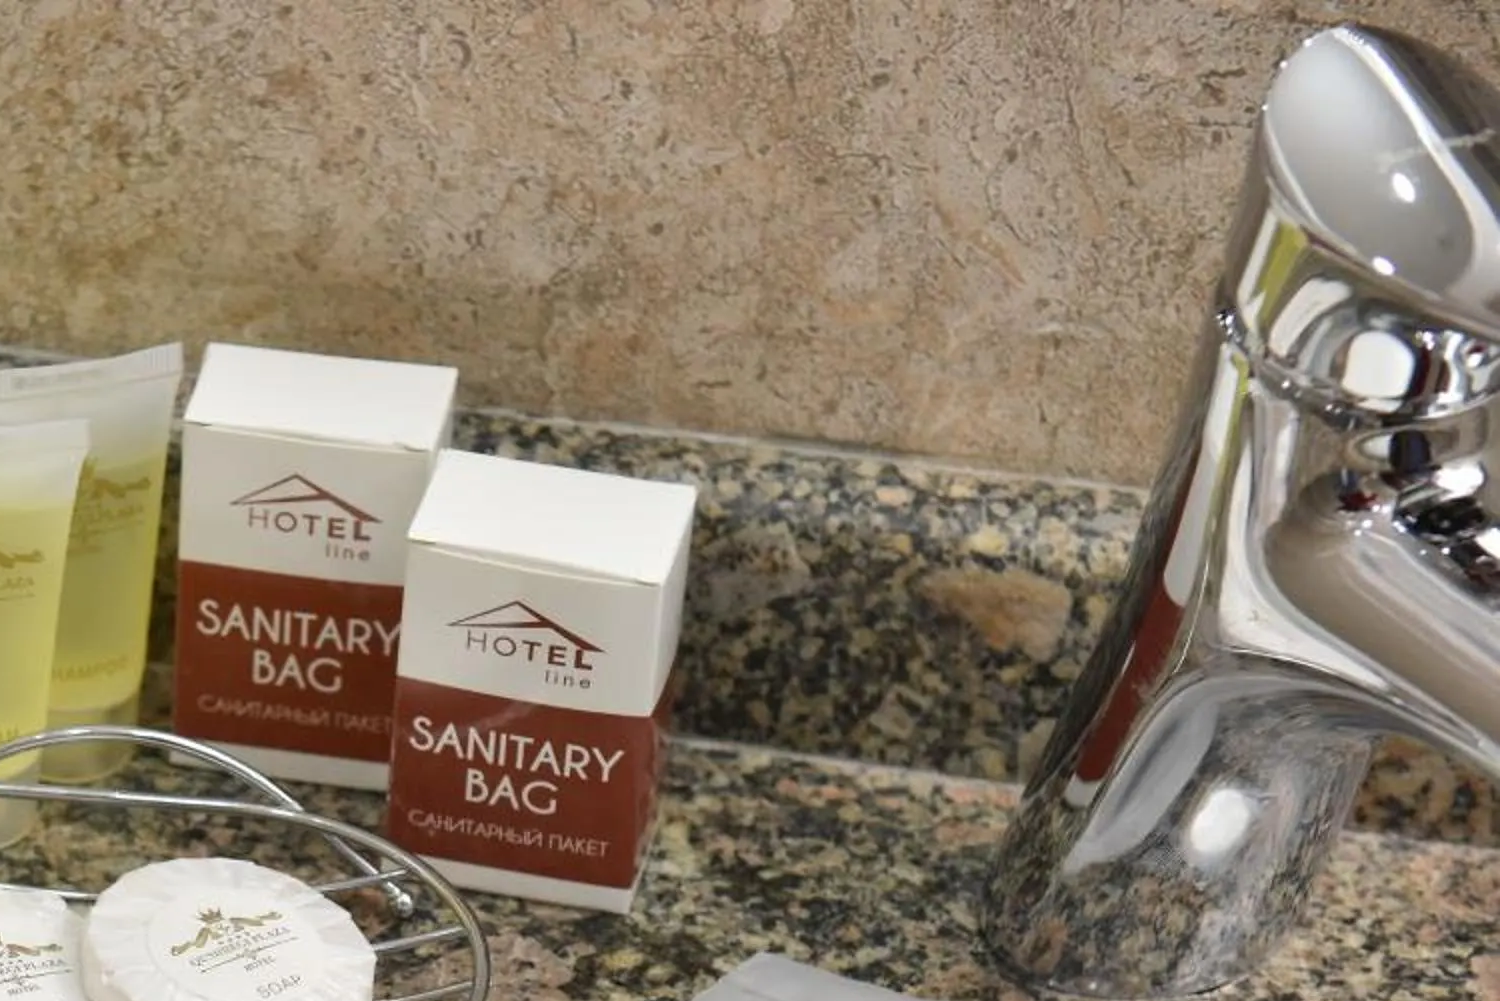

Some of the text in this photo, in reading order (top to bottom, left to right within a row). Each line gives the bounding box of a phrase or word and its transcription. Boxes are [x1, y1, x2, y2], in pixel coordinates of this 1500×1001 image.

[247, 506, 372, 542] HOTEL
[325, 543, 371, 561] line
[196, 598, 402, 657] SANITARY
[466, 629, 593, 670] HOTEL
[252, 650, 343, 693] BAG
[544, 670, 591, 690] line
[408, 715, 625, 783] SANITARY
[465, 768, 558, 815] BAG
[407, 808, 610, 858] САНИТАРНЫЙ ПАКЕТ
[256, 974, 302, 1000] SOAP
